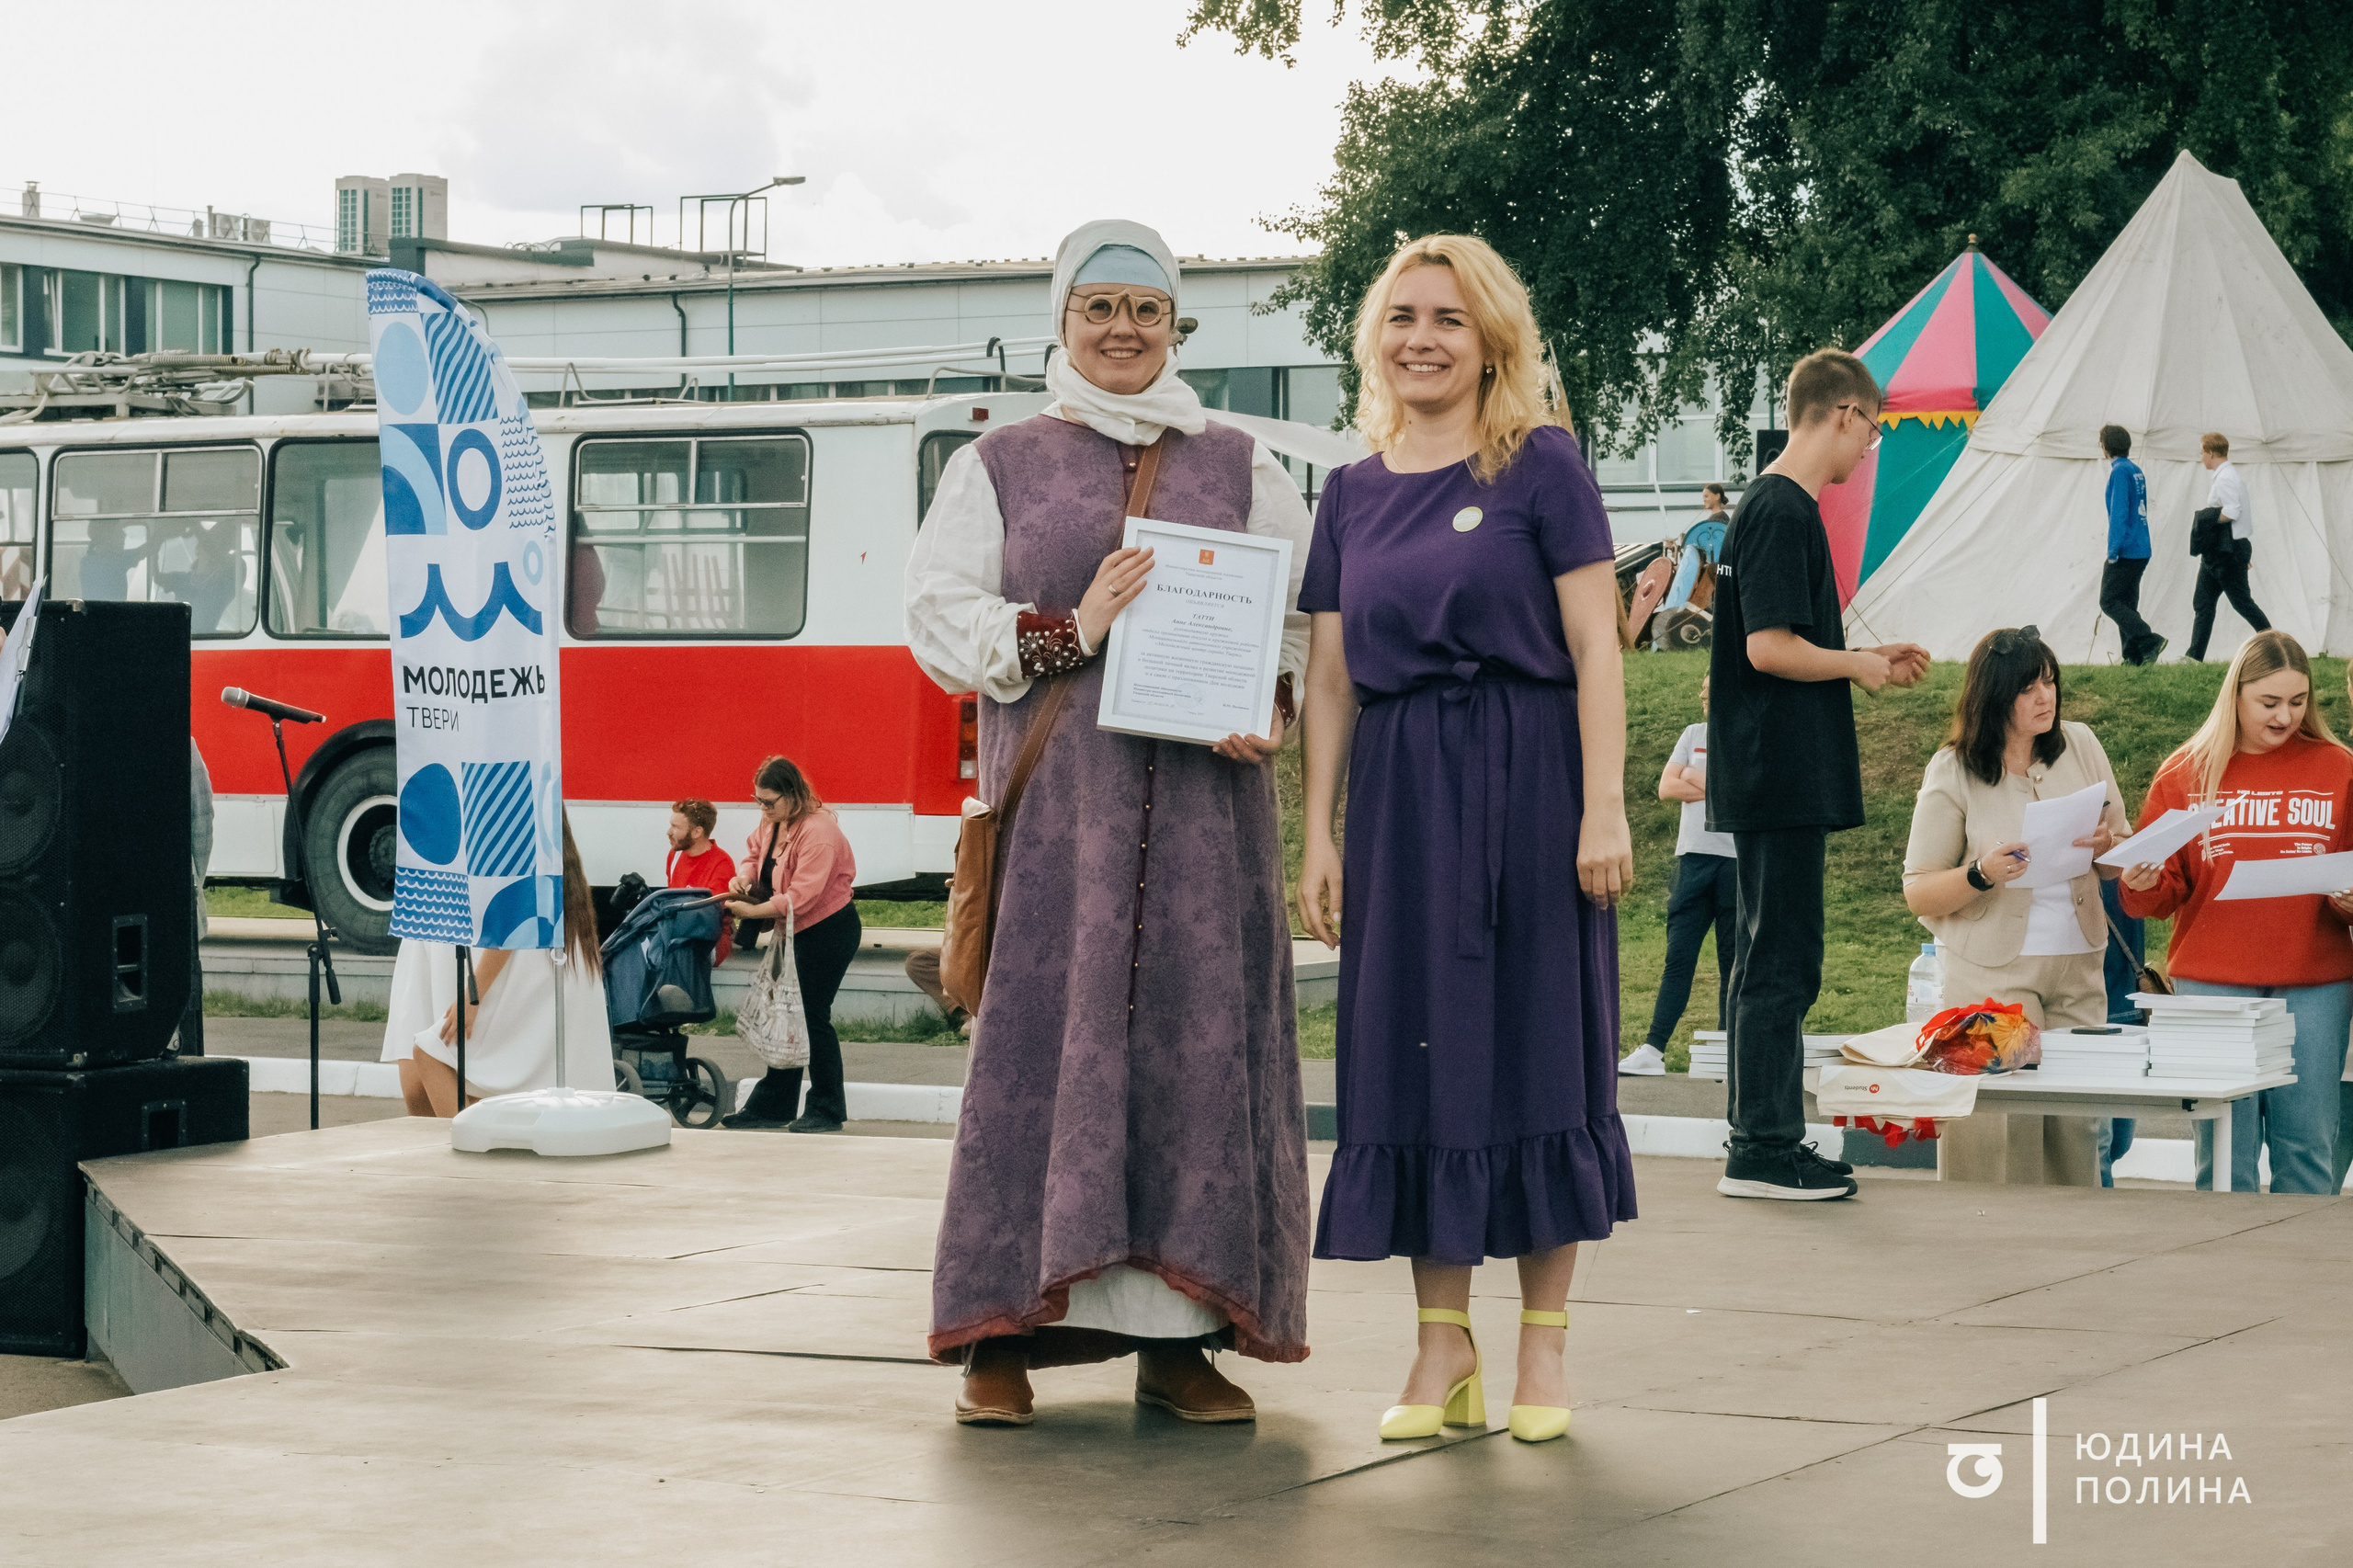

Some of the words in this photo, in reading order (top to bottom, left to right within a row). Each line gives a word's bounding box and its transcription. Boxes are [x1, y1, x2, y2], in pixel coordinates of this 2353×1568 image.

[1156, 584, 1252, 605] БЛАГОДАРНОСТЬ
[1185, 598, 1224, 608] ОБЪЯВЛЯЕТСЯ
[403, 665, 545, 704] МОЛОДЕЖЬ
[406, 707, 460, 732] ТВЕРИ
[2188, 798, 2281, 829] EATIVE
[2287, 797, 2336, 830] SOUL
